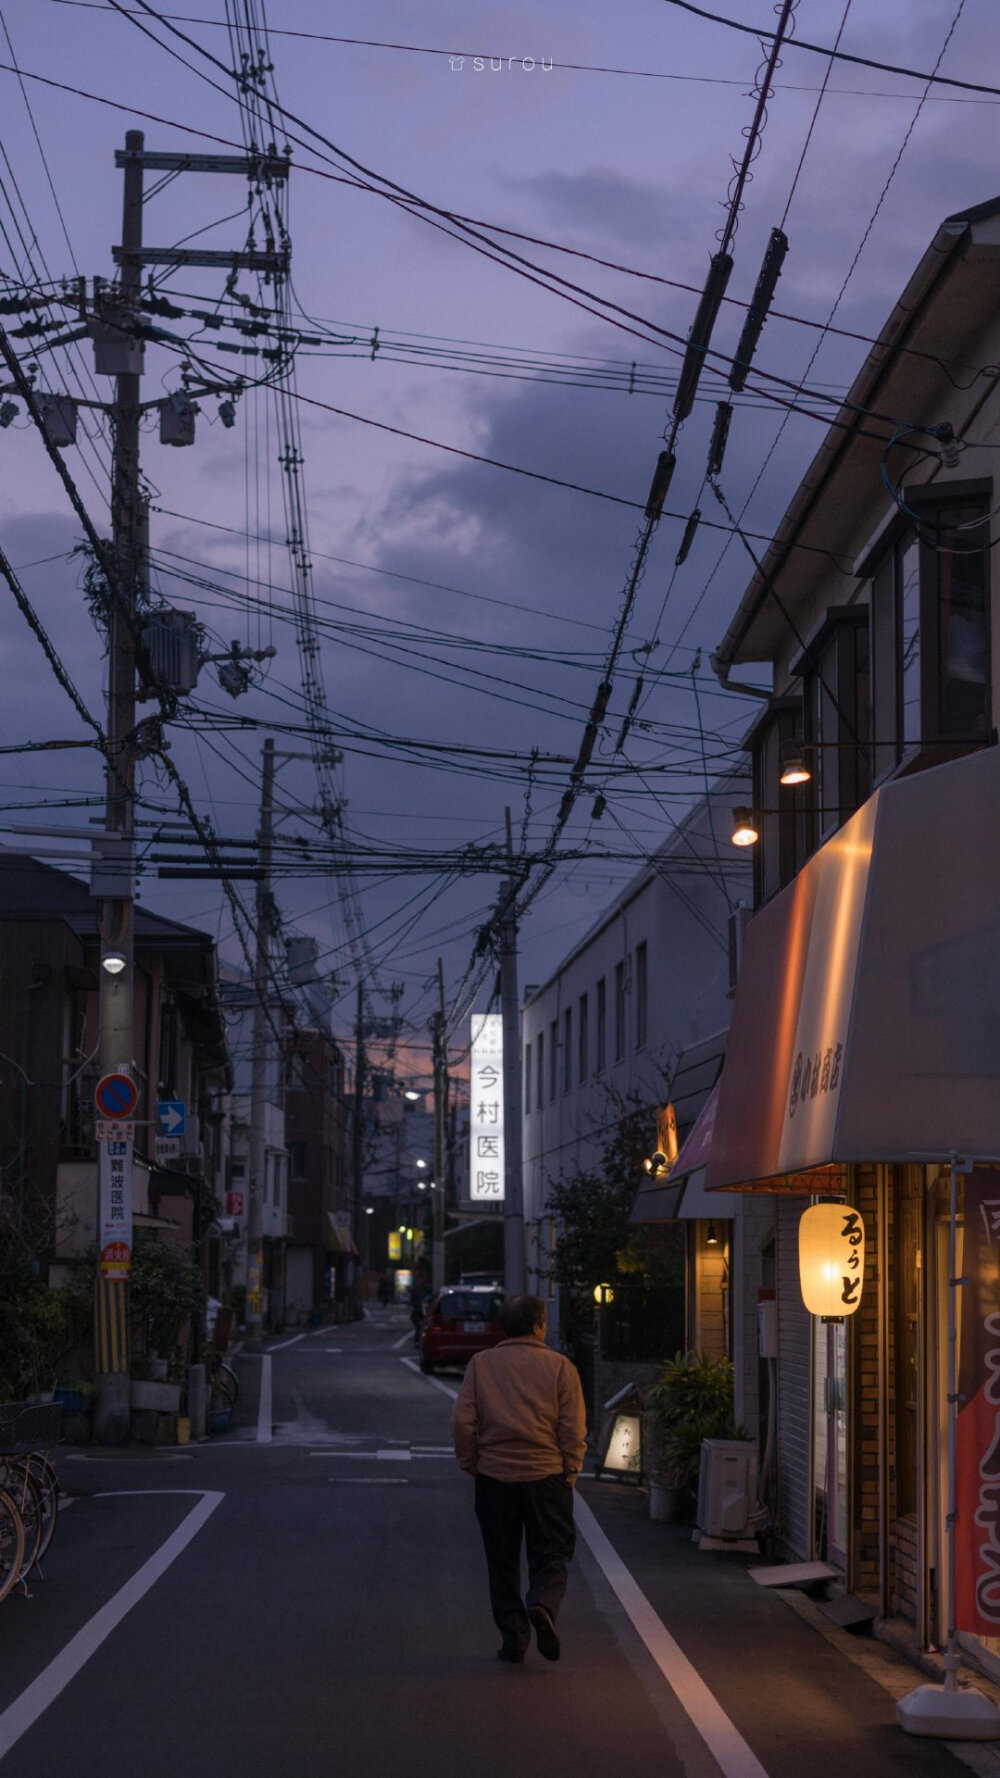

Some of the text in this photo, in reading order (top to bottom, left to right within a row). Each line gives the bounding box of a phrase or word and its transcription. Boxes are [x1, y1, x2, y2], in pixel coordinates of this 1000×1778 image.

[476, 1065, 500, 1194] 今村医院
[110, 1159, 124, 1220] 難波医院
